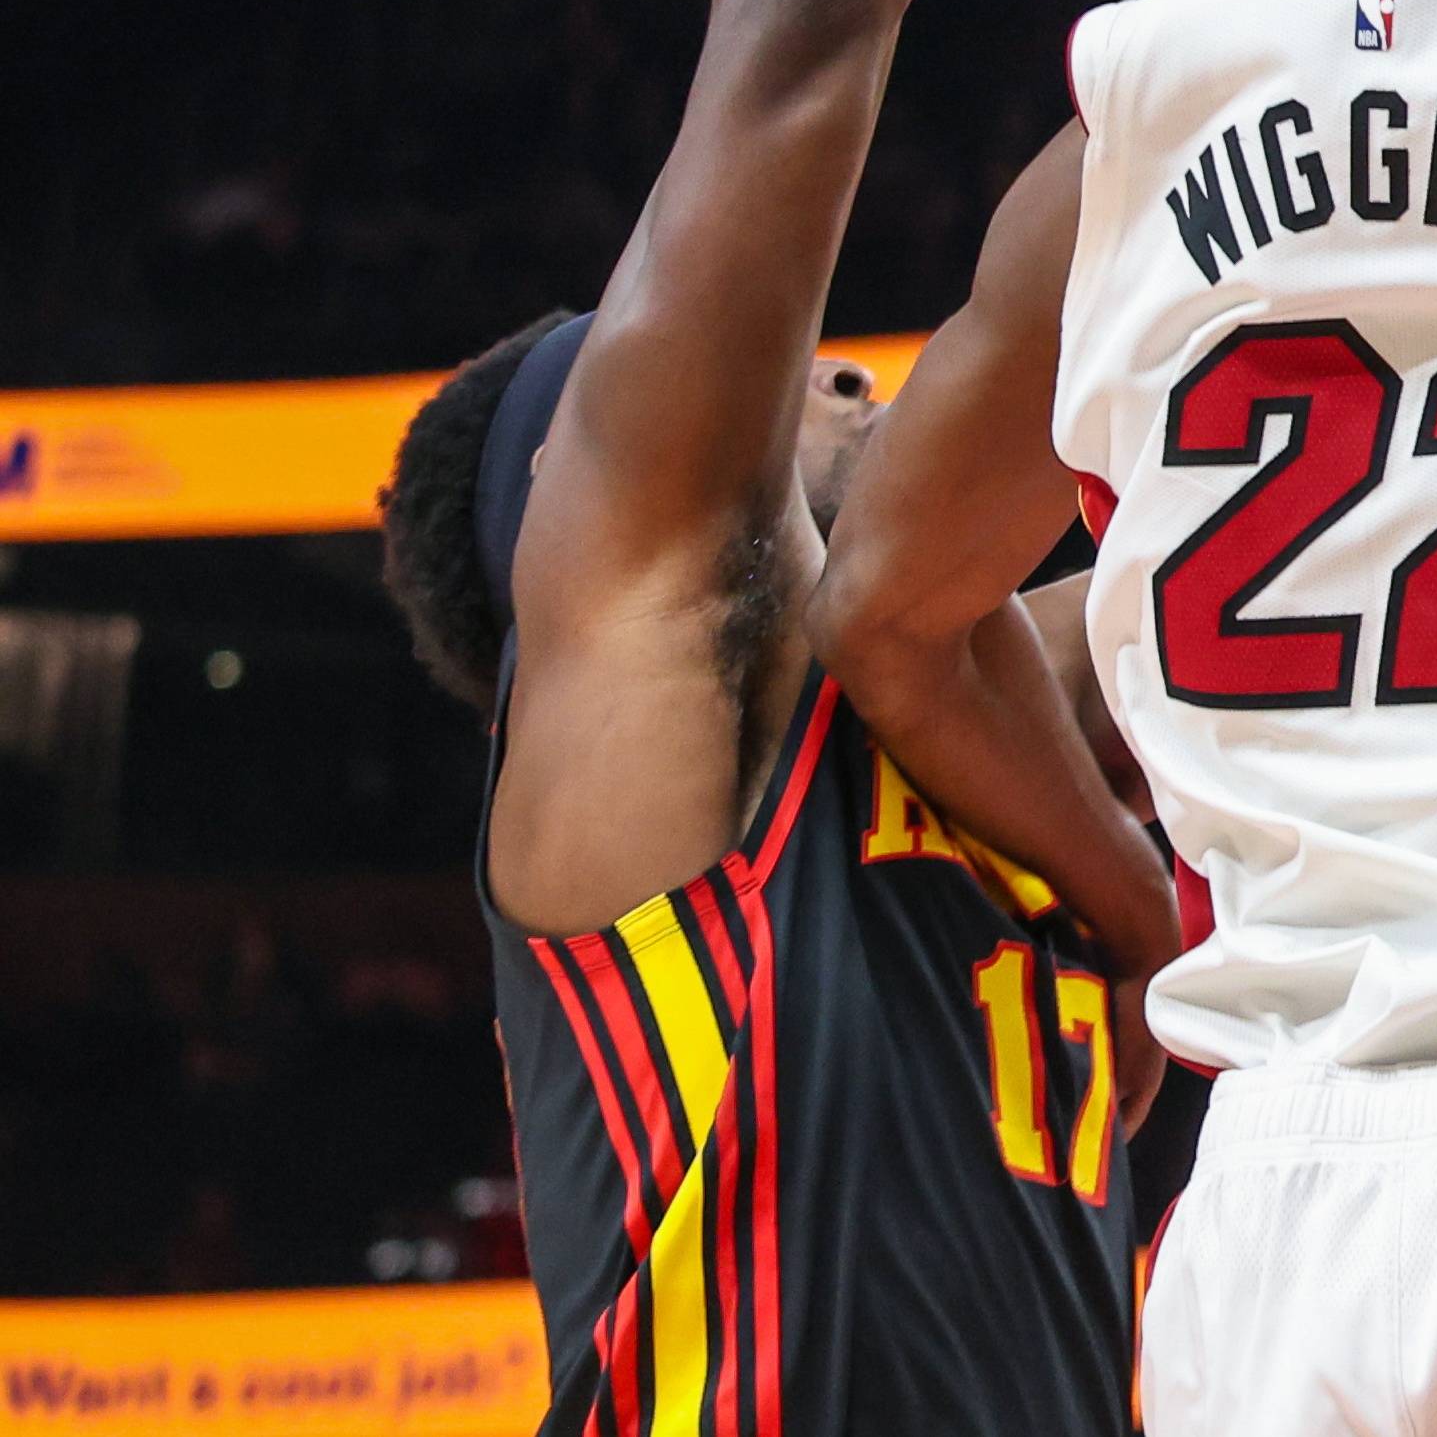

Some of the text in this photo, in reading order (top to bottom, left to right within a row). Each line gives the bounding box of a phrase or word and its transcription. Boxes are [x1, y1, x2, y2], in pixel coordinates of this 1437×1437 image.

[1357, 29, 1379, 48] NBA
[972, 939, 1117, 1207] 17
[7, 1361, 170, 1415] Want
[191, 1370, 219, 1413] a
